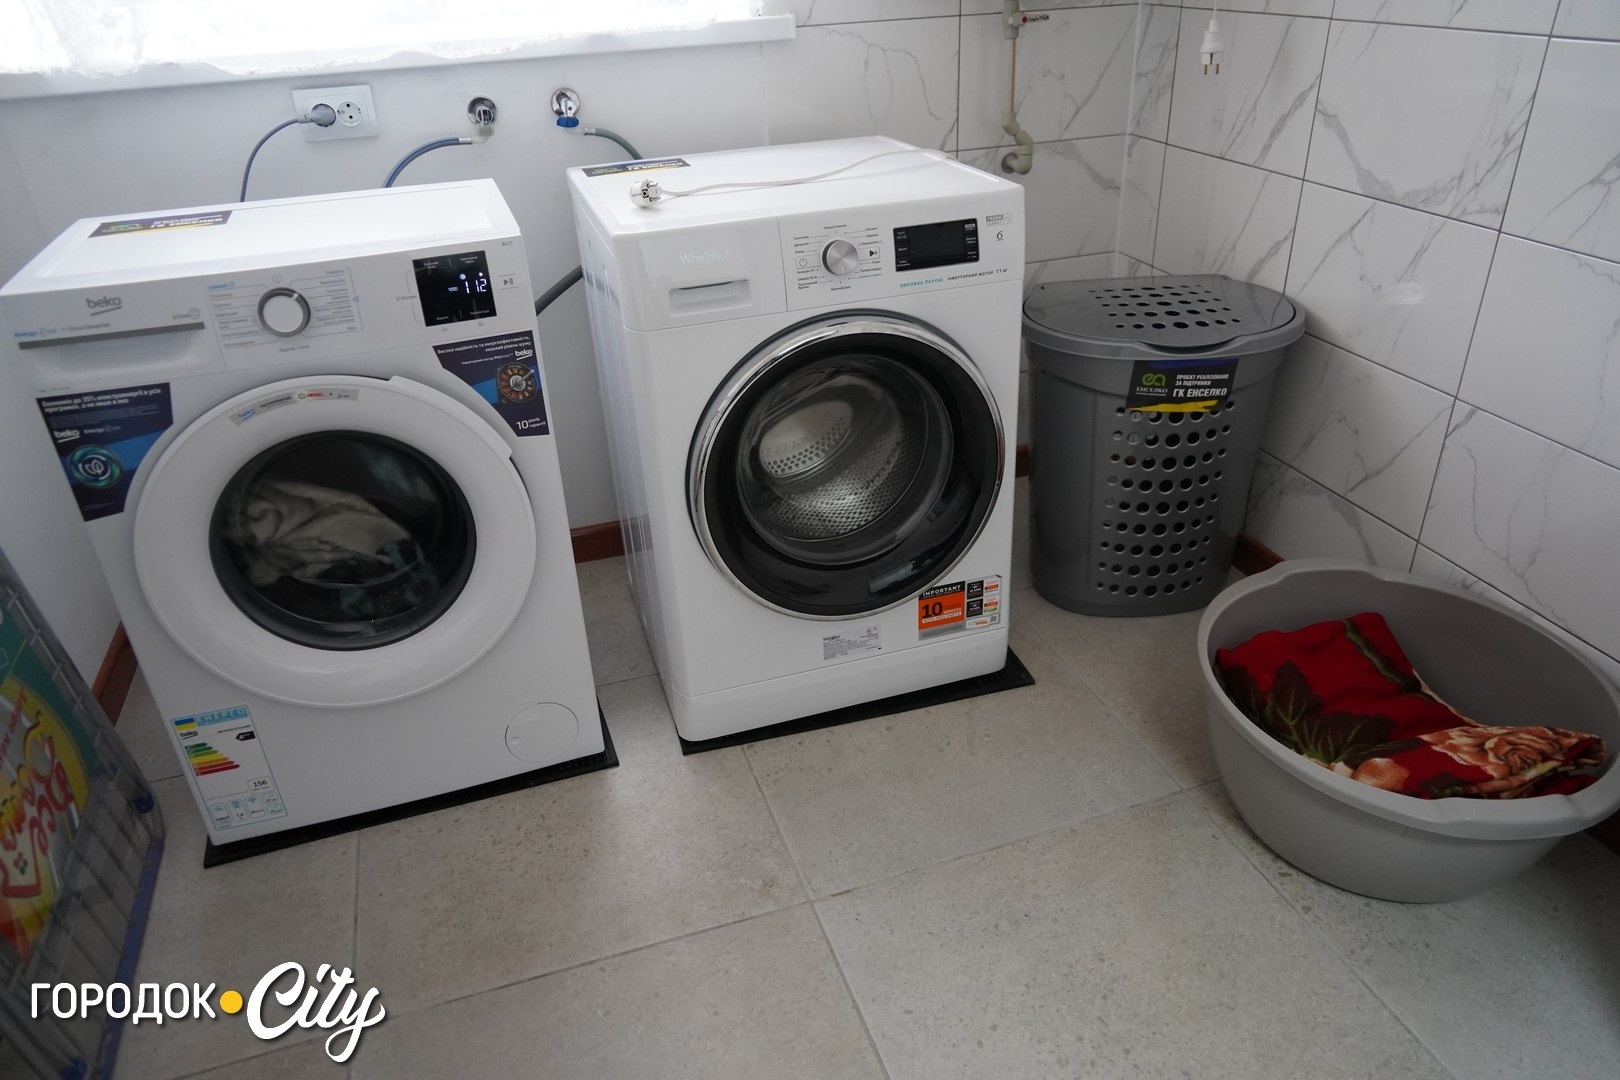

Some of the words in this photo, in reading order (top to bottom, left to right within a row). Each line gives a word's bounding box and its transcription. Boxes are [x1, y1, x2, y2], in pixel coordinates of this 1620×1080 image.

[680, 247, 729, 264] Whirlpool
[86, 296, 122, 310] beko
[515, 348, 533, 357] beko
[1172, 388, 1186, 398] ГК
[1186, 387, 1228, 398] ЕНСЕЛКО
[516, 419, 529, 430] 10
[53, 428, 80, 439] beko
[922, 584, 961, 597] IMPORTANT
[921, 601, 943, 619] 10
[252, 779, 268, 788] 156
